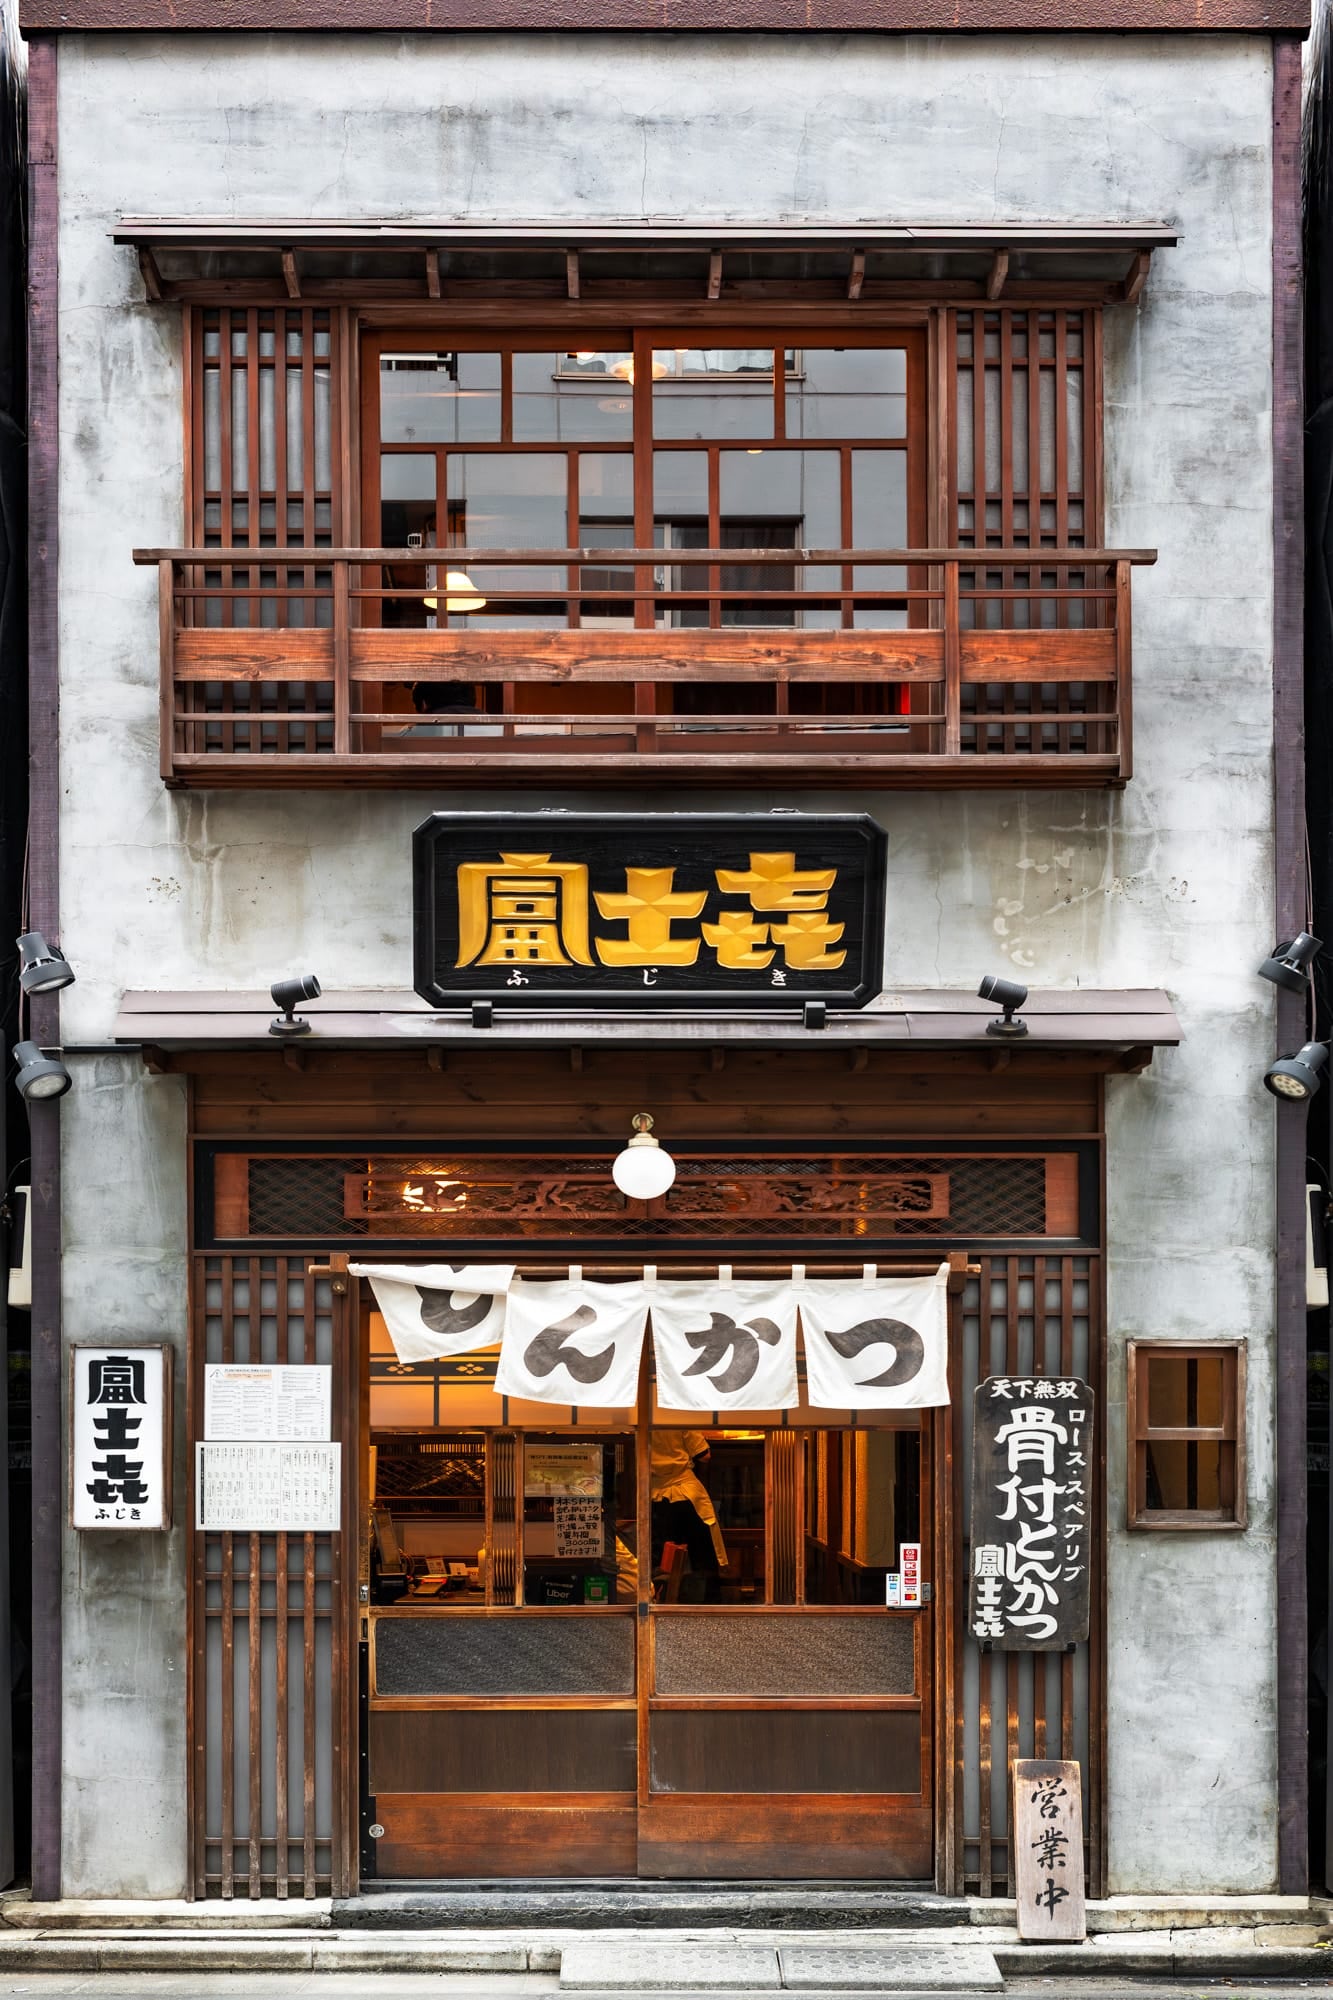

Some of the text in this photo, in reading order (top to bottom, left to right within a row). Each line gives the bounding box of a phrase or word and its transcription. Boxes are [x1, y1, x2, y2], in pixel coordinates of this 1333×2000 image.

[990, 1379, 1079, 1399] 天下無双
[94, 1508, 142, 1521] ふじき
[994, 1405, 1068, 1640] 骨付とんかつ
[1031, 1777, 1070, 1921] 営業中
